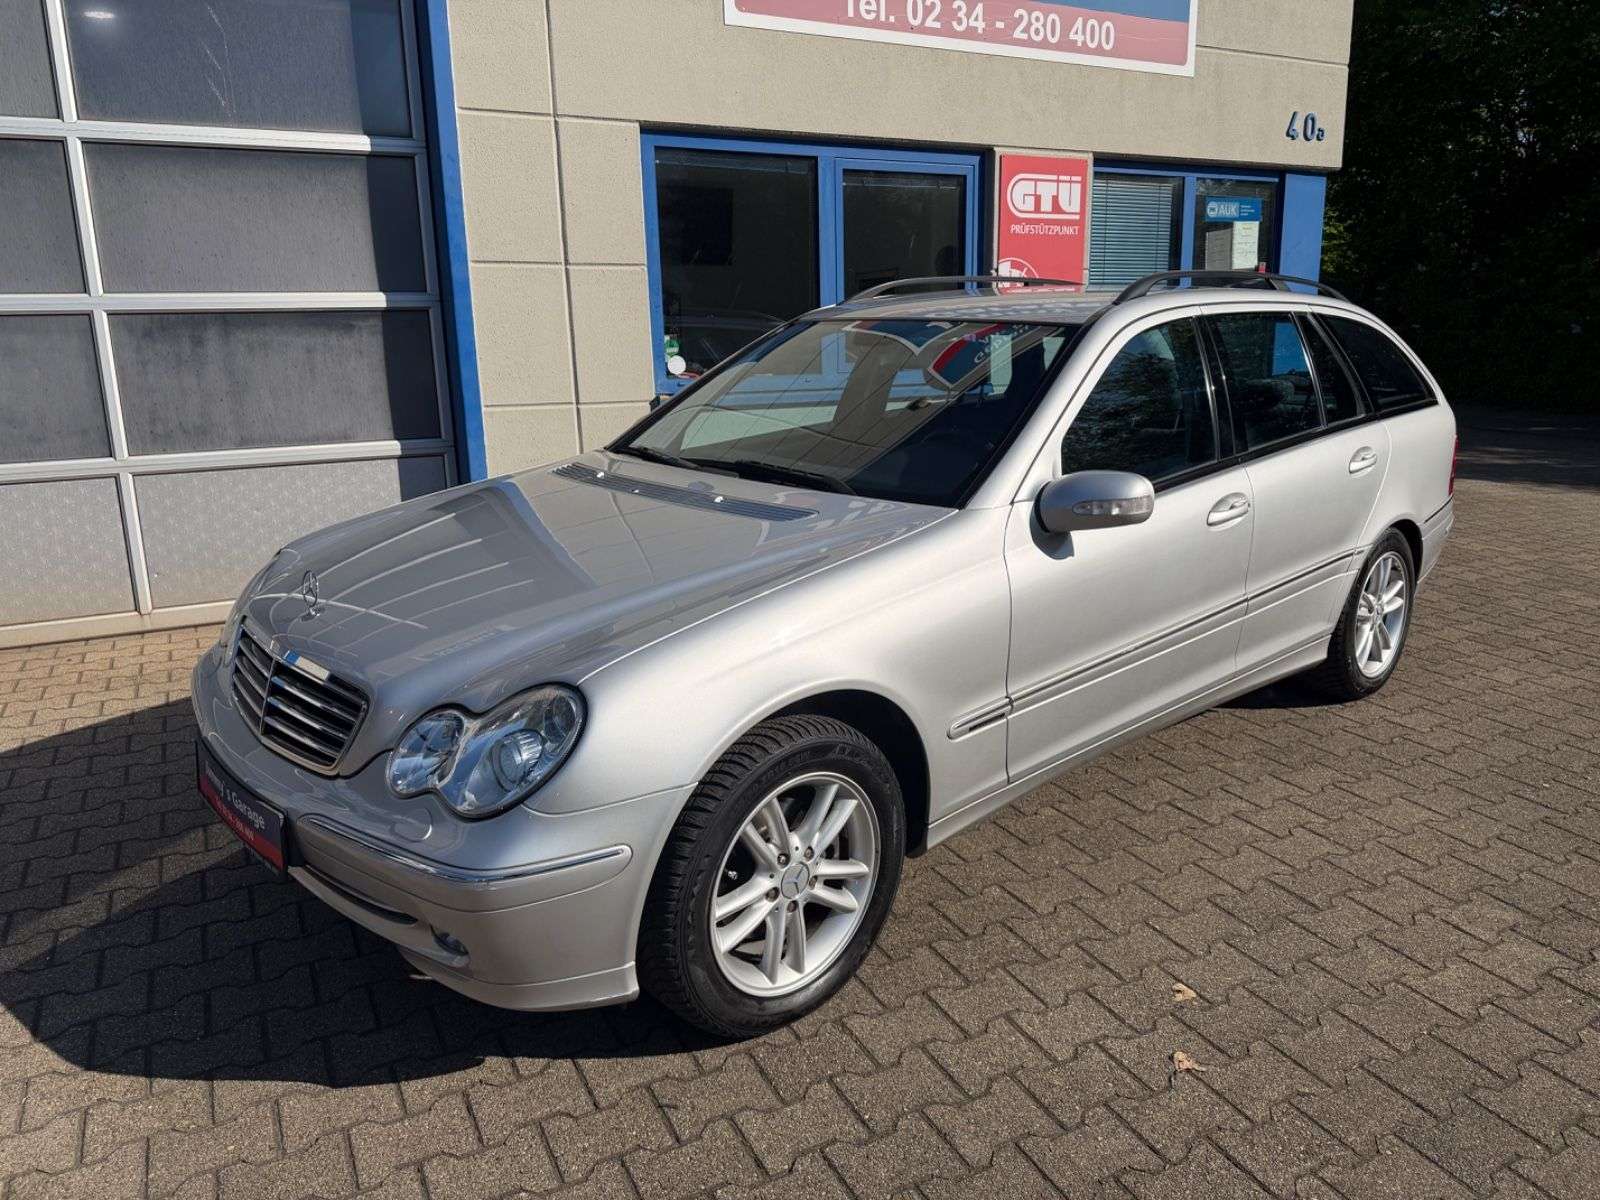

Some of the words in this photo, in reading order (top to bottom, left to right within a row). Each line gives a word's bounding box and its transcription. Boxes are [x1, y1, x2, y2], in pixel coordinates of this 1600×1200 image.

[906, 0, 941, 28] 02
[951, 0, 986, 34] 34
[1012, 8, 1061, 44] 280
[1068, 16, 1115, 51] 400
[1007, 173, 1082, 220] GTÜ
[1010, 222, 1080, 235] PRÜFSTÜTZPUNKT
[232, 791, 265, 830] Garage
